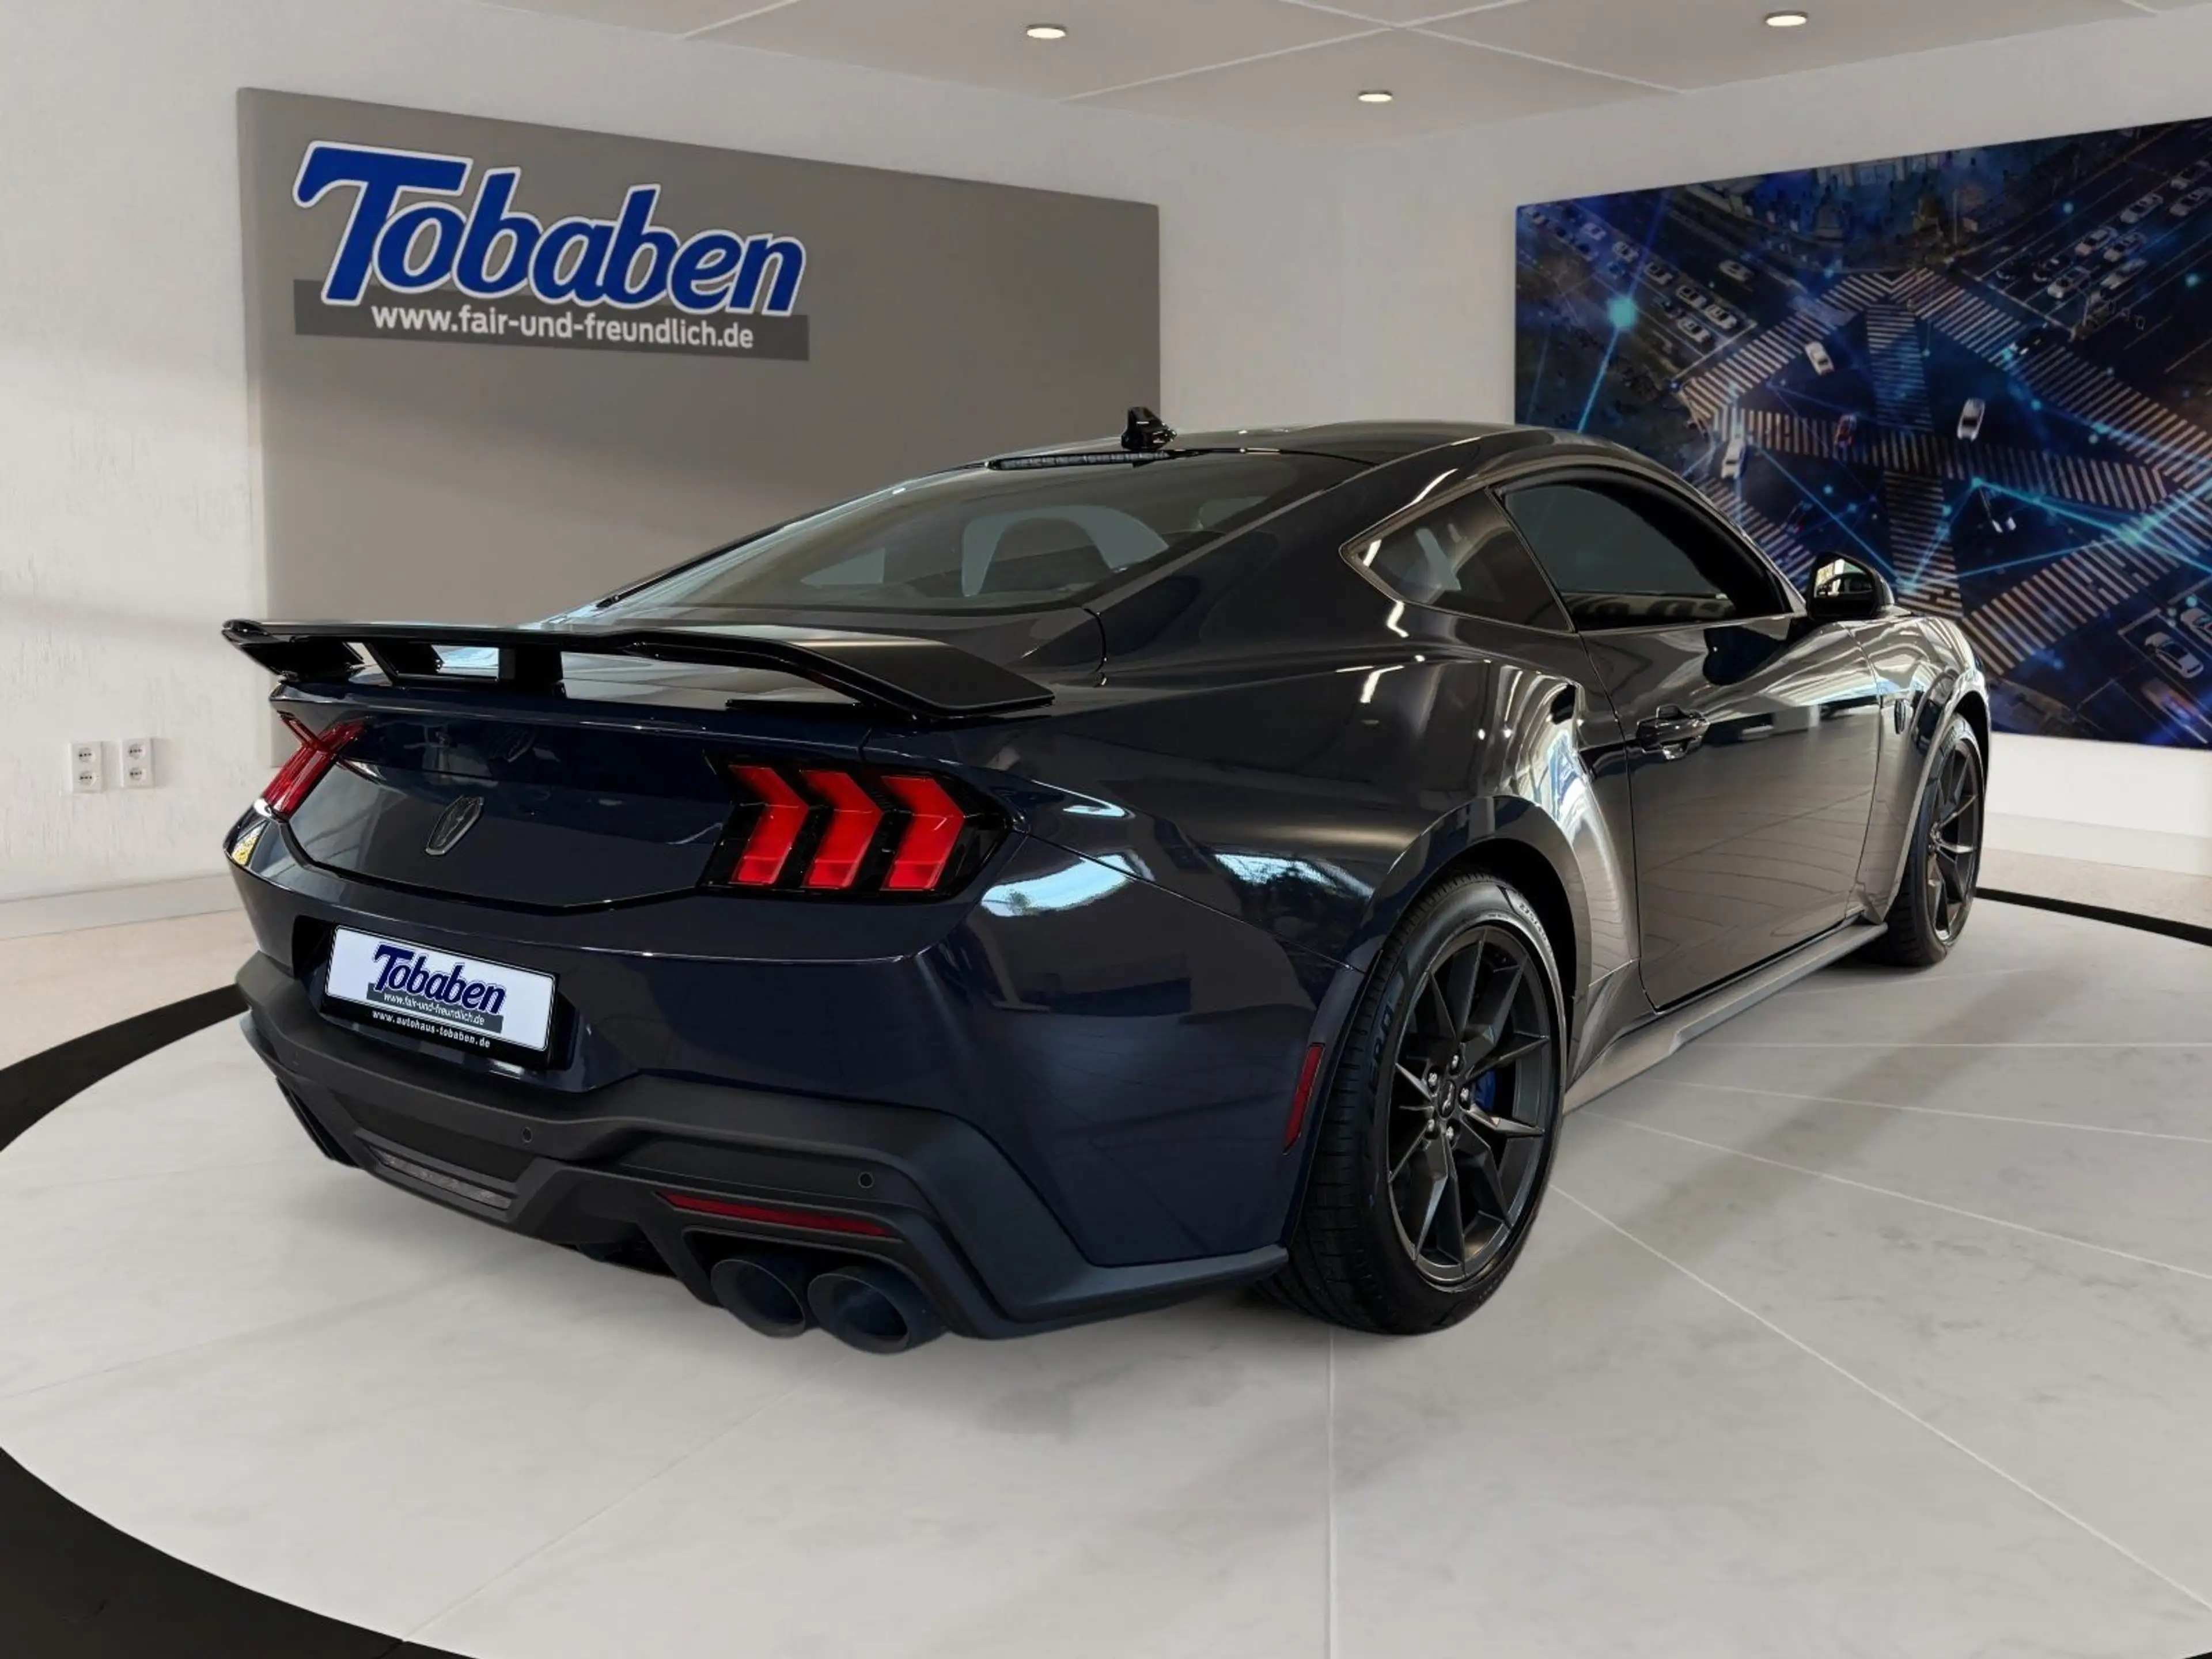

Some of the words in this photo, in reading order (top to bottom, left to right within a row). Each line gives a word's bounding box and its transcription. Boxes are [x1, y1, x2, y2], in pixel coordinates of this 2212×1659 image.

[293, 141, 806, 316] Tobaben
[371, 304, 754, 349] www.fair-und-freundlich.de
[373, 942, 506, 1014] Tobaben
[372, 1010, 491, 1048] www.autohaus-tobaben.de
